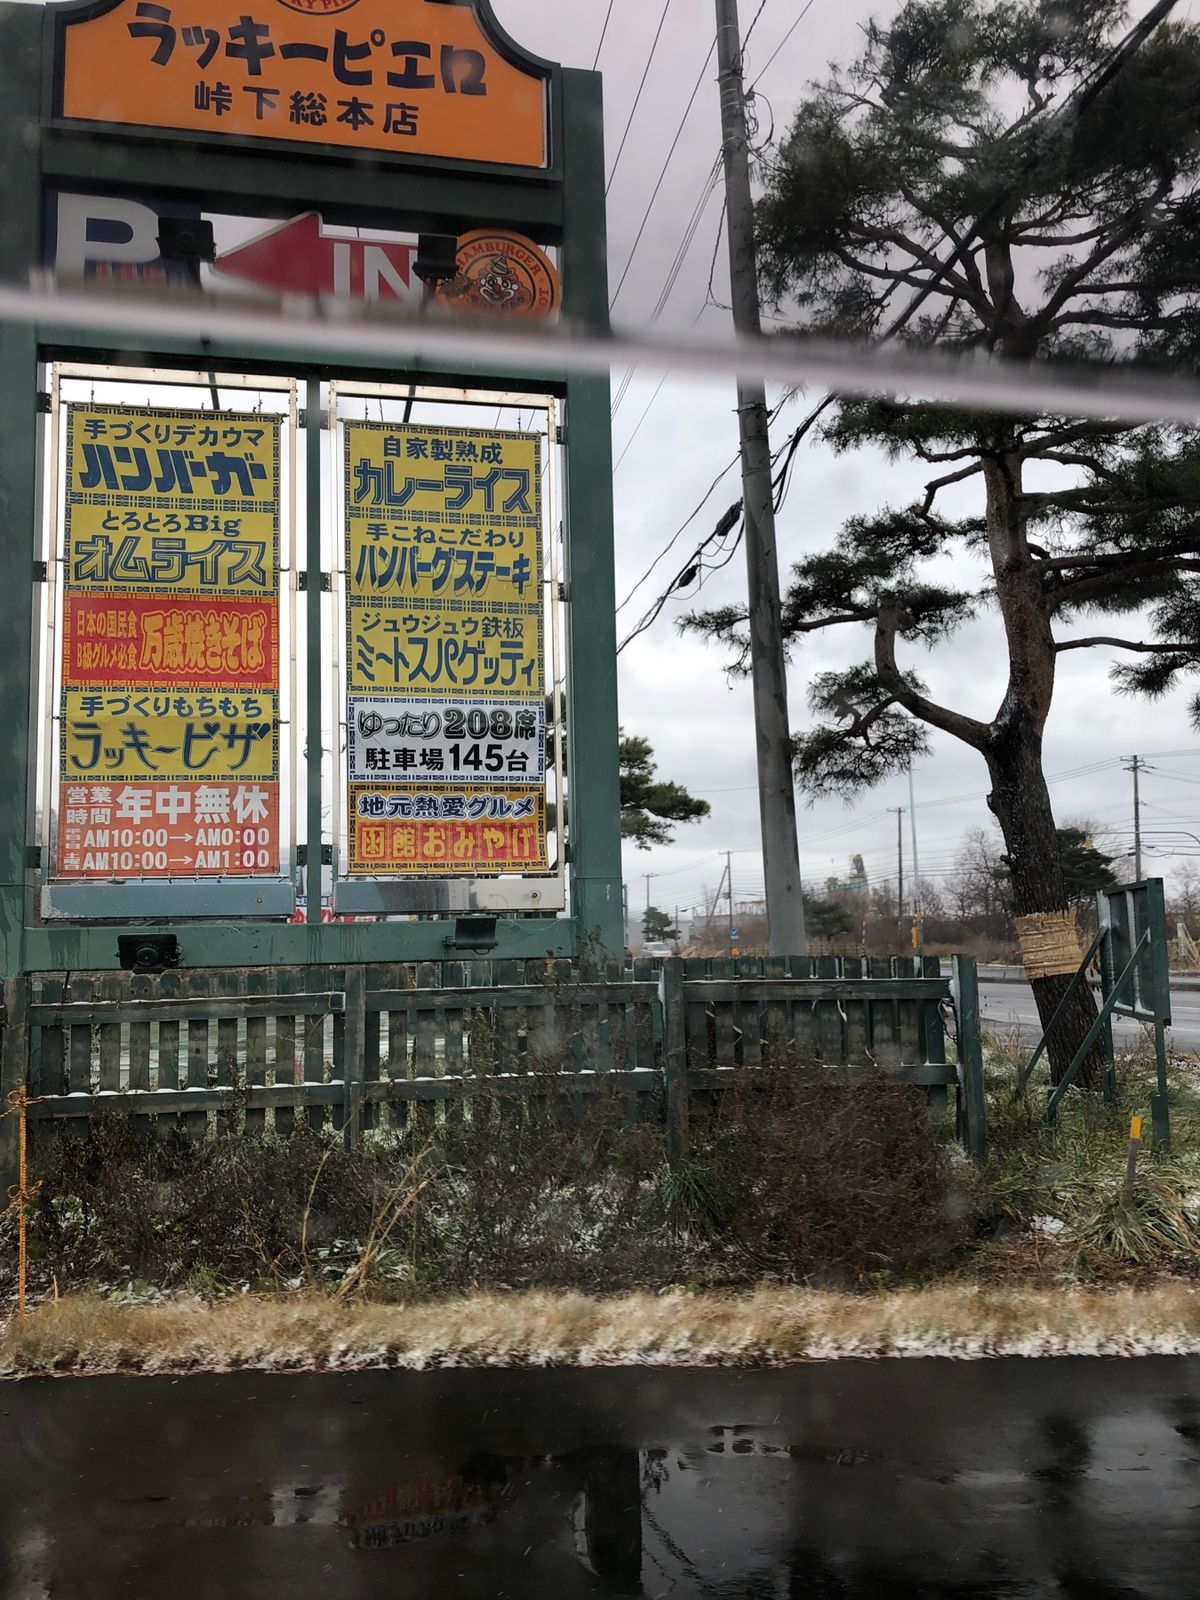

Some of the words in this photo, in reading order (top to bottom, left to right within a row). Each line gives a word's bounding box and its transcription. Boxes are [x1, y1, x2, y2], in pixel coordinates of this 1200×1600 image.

[128, 2, 487, 96] ラッキーピエロ
[194, 80, 419, 137] 峠下総本店
[84, 419, 265, 447] 手づくりデカウマ
[383, 435, 504, 465] 自家製熟成
[79, 443, 268, 497] ハンバーガー
[354, 458, 533, 514] カレーライス
[101, 510, 241, 537] とろとろBig
[366, 523, 524, 549] 手こねこだわり
[75, 534, 267, 587] オムライス
[77, 609, 138, 638] 日本の国民食
[361, 611, 525, 639] ジュウジュウ鉄板
[140, 609, 267, 674] 万歳焼きそば
[77, 642, 138, 671] B級グルメ必食
[356, 634, 536, 687] ミートスパゲッティ
[79, 695, 263, 718] 手づくりもちもち
[365, 743, 530, 773] 駐車場145台
[67, 786, 112, 804] 営業
[115, 784, 270, 826] 年中無休
[358, 792, 536, 821] 地元熱愛グルメ
[66, 808, 111, 825] 時間
[83, 829, 168, 848] AM10:00
[195, 828, 270, 847] AM0:00
[361, 826, 535, 859] 函館おみやげ
[82, 851, 168, 870] AM10:00
[194, 850, 270, 869] AM1:00
